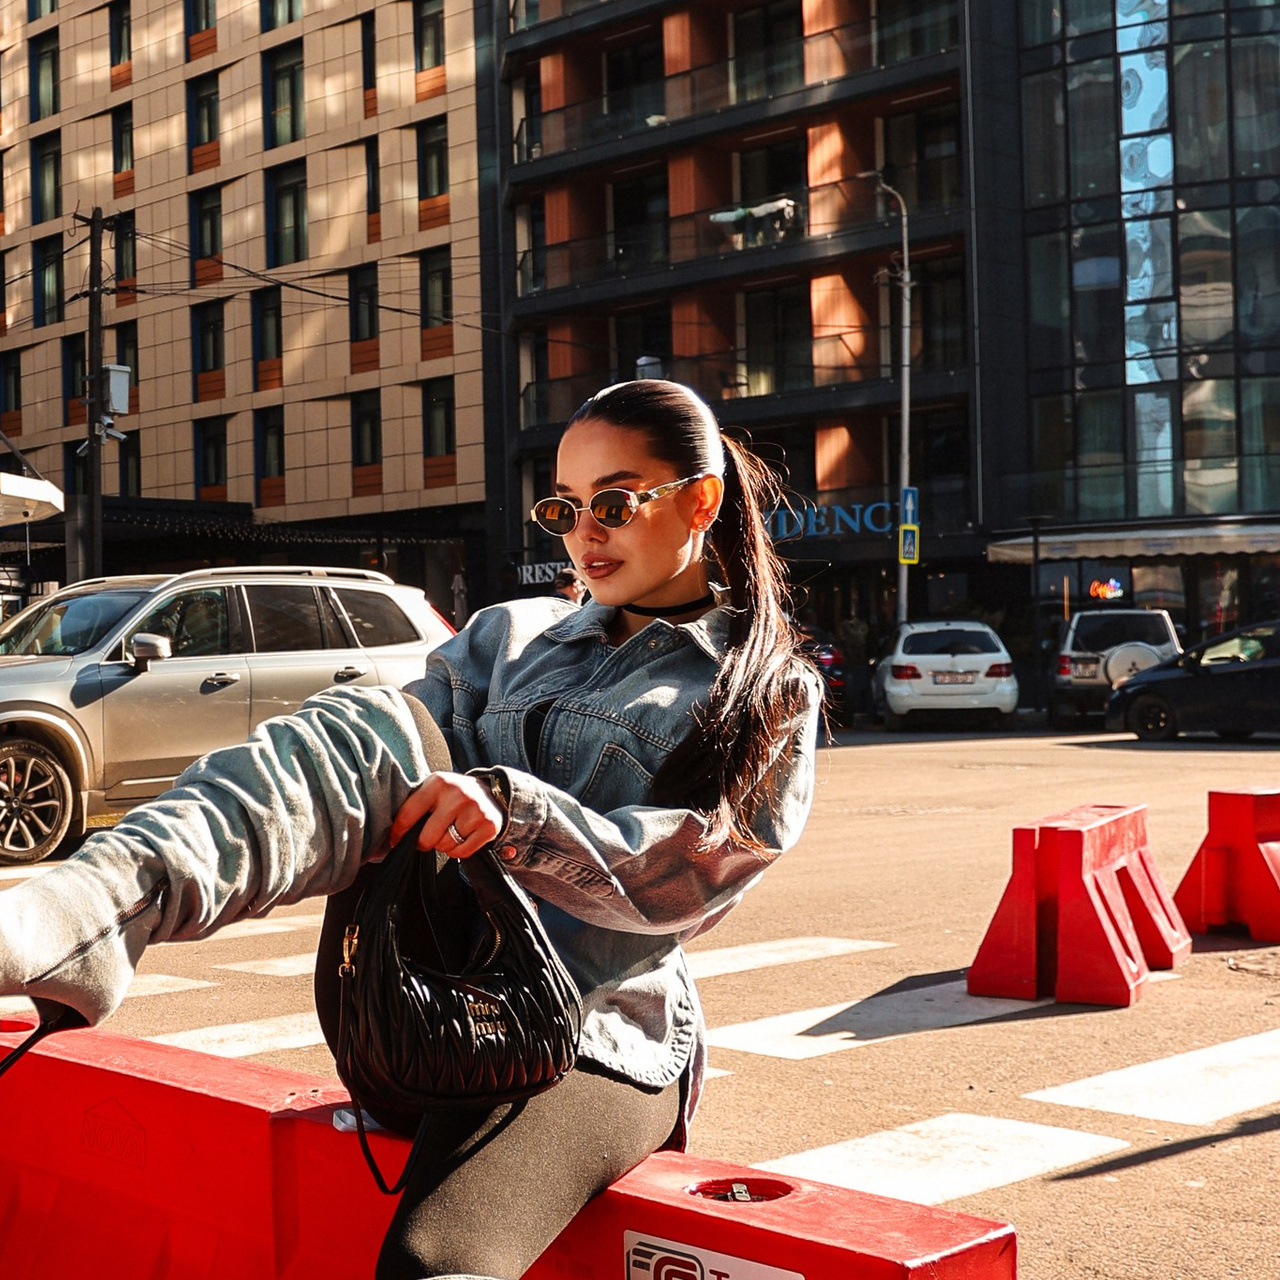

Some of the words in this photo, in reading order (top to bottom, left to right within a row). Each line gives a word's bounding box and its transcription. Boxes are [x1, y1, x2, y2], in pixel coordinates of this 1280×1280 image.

[468, 1000, 500, 1016] miu
[475, 1020, 507, 1036] miu
[80, 1117, 143, 1162] NOVA
